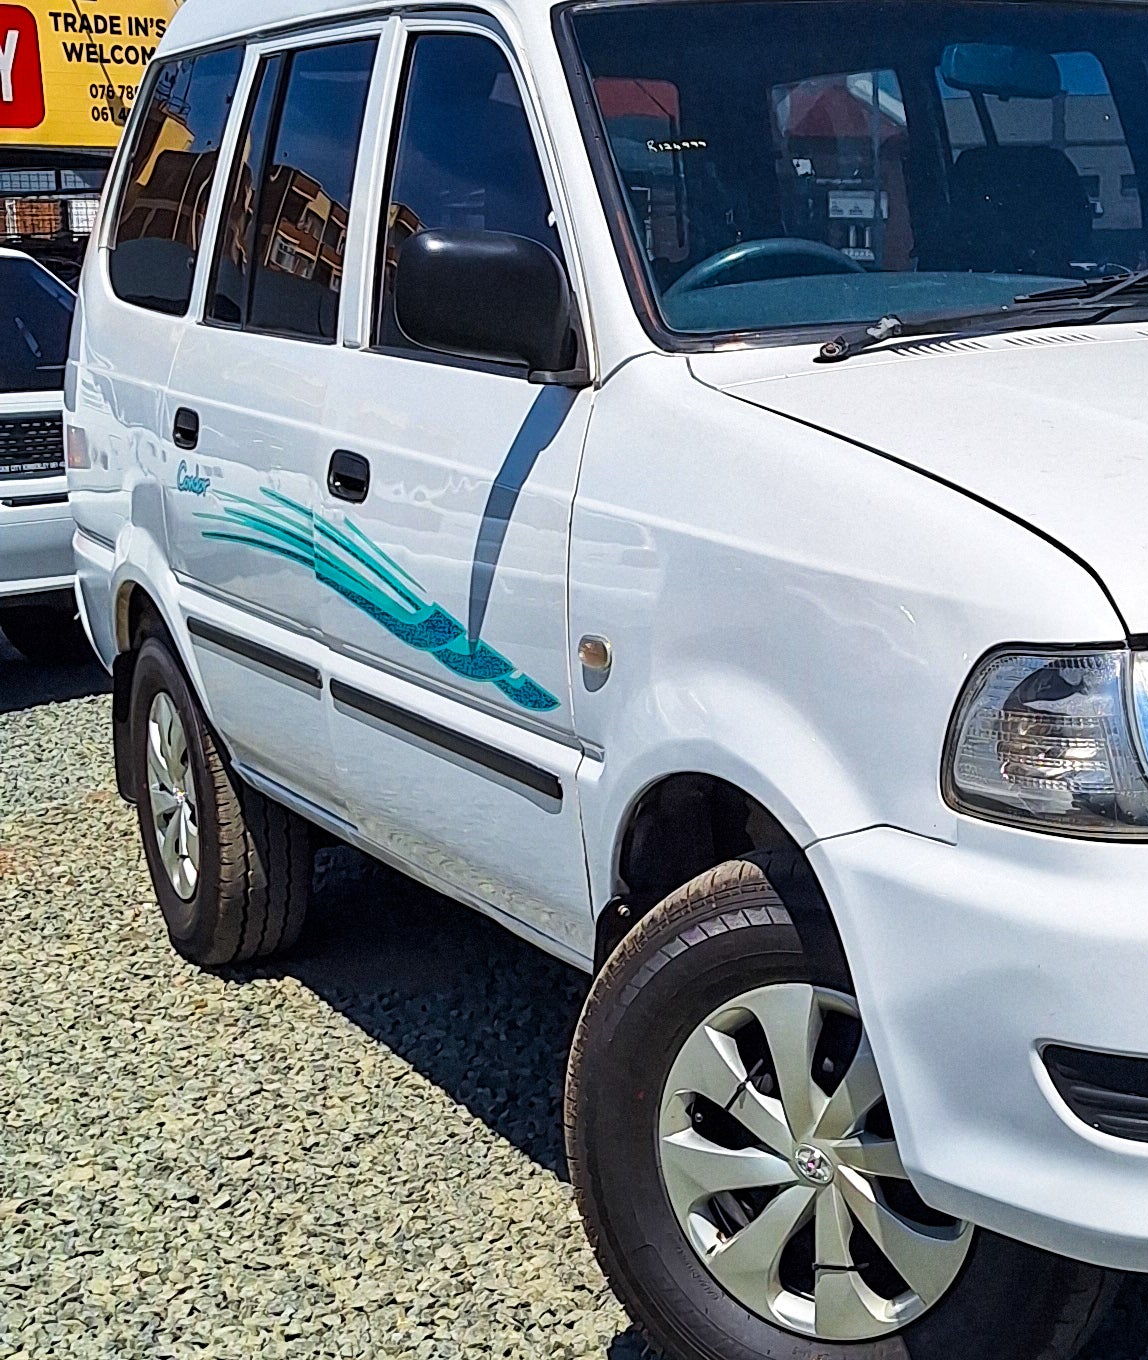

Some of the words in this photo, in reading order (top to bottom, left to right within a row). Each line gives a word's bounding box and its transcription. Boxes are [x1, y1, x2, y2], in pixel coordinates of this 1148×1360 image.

[49, 12, 122, 35] TRADE
[128, 16, 167, 38] IN'S
[62, 42, 157, 66] WELCOM
[90, 83, 115, 100] 076
[92, 106, 115, 122] 061
[118, 107, 132, 124] 4
[177, 459, 211, 498] Condor
